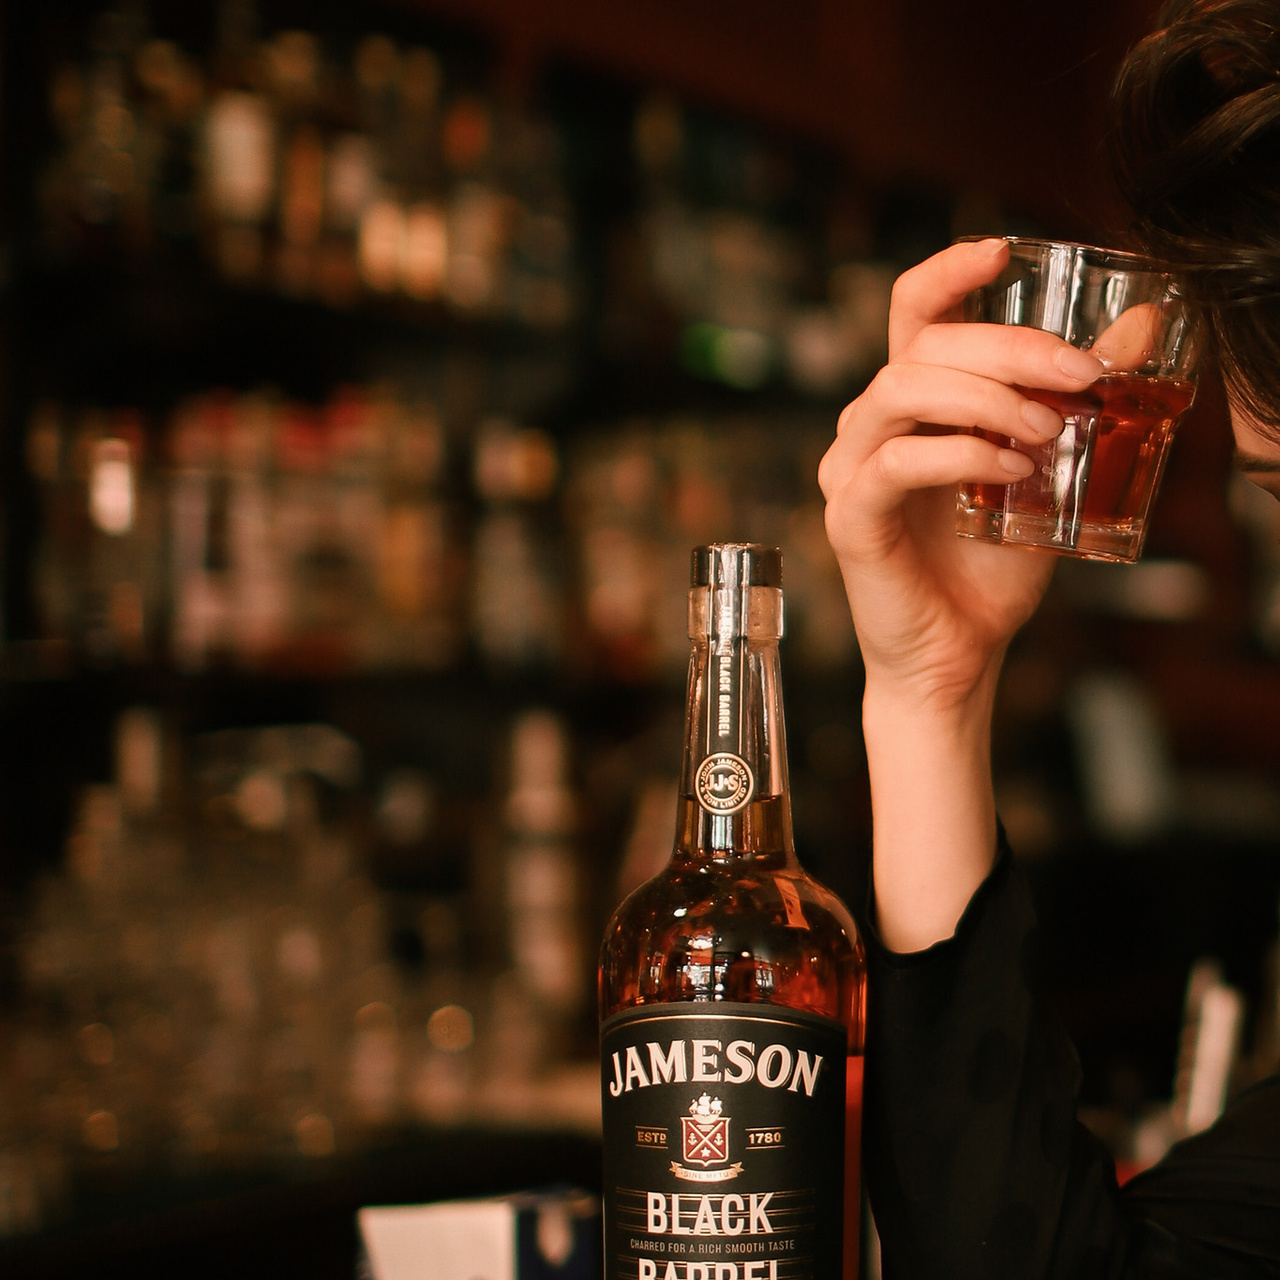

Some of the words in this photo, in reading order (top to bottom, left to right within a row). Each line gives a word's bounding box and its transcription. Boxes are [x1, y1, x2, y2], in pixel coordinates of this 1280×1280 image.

[720, 657, 731, 691] BLACK
[719, 696, 730, 738] BARREL
[716, 758, 748, 782] JAMESON
[609, 1039, 824, 1097] JAMESON
[748, 1131, 782, 1145] 1780
[647, 1191, 775, 1236] BLACK
[630, 1238, 666, 1252] CHARRED
[667, 1240, 686, 1254] FOR
[689, 1241, 696, 1254] A
[699, 1241, 722, 1254] RICH
[725, 1241, 765, 1254] SMOOTH
[768, 1239, 795, 1251] TASTE
